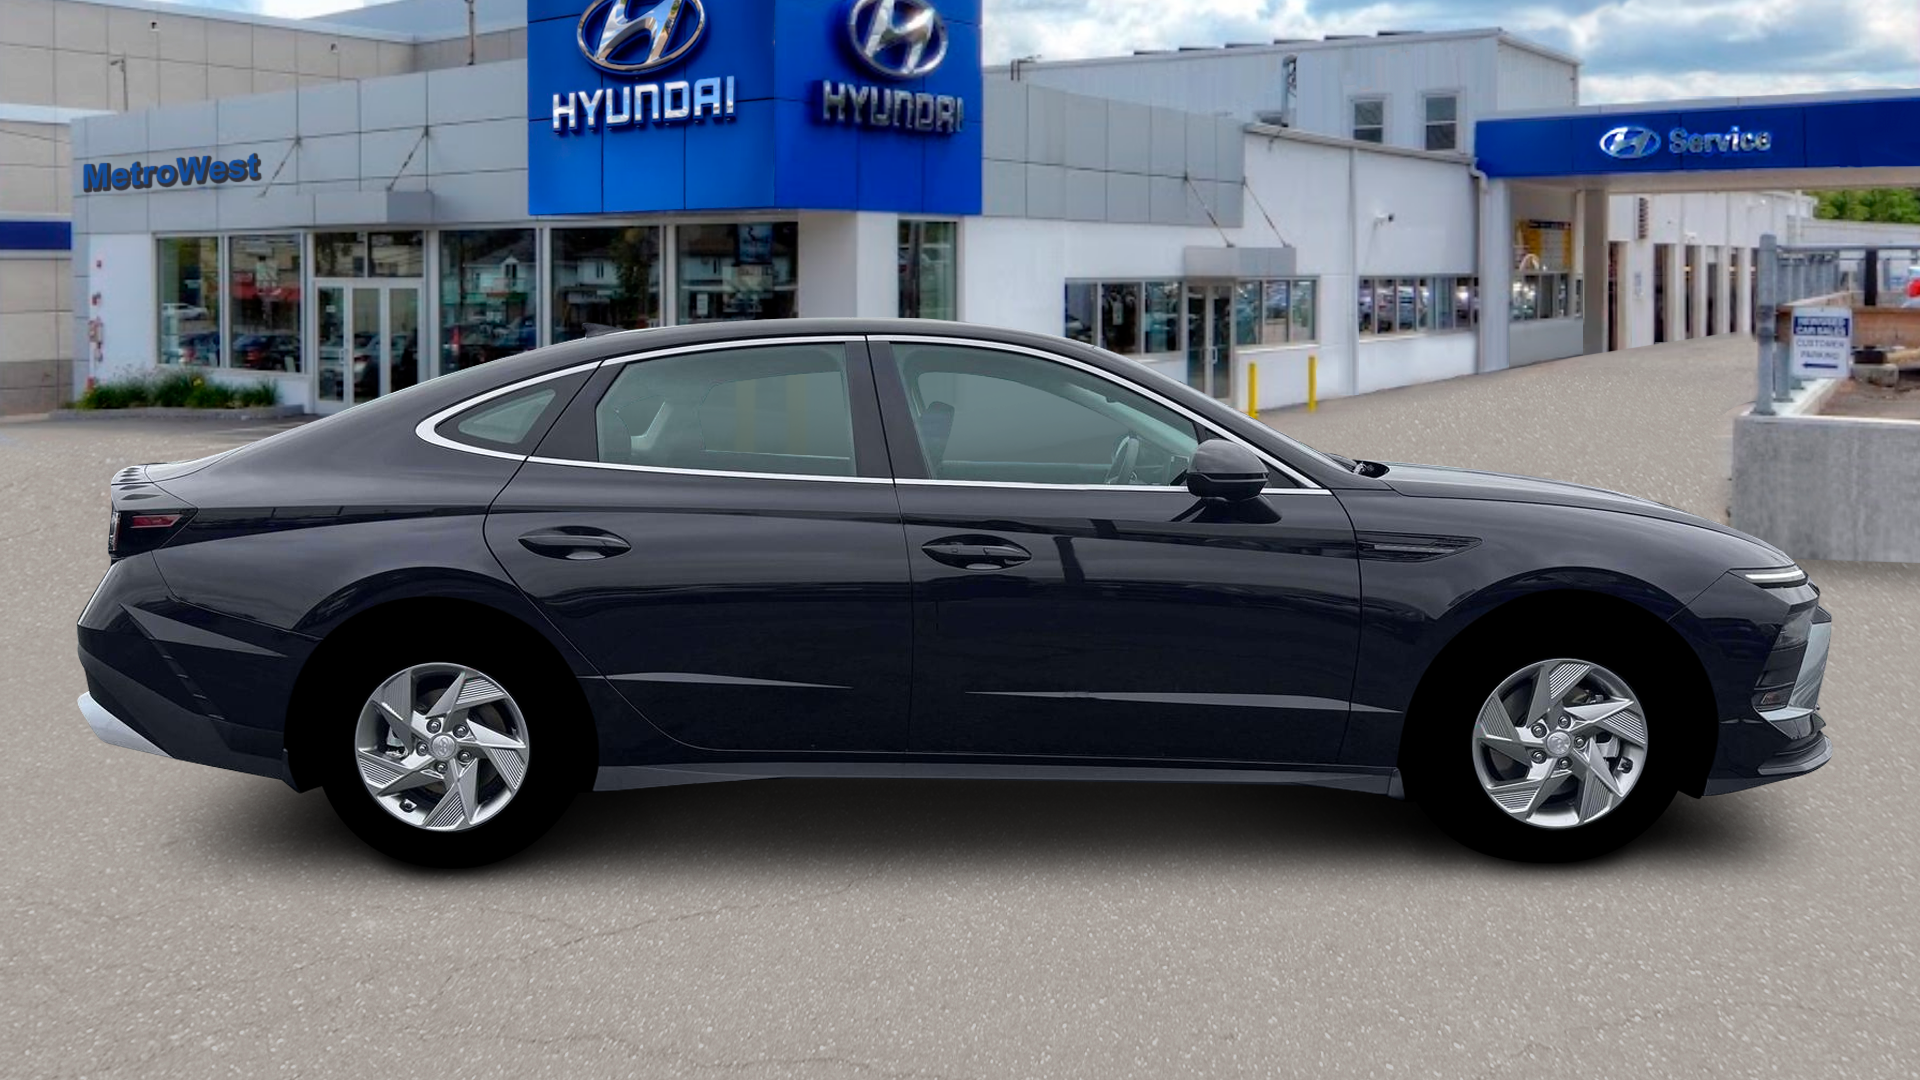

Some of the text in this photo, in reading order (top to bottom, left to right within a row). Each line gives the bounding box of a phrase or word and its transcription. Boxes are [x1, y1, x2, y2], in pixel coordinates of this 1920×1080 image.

[552, 76, 736, 132] HYUNDAI
[823, 80, 965, 133] HYUNDAI
[1669, 126, 1772, 154] Service
[83, 153, 262, 192] MetroWest
[1796, 339, 1845, 348] CUSTOMER
[1800, 350, 1840, 360] PARKING
